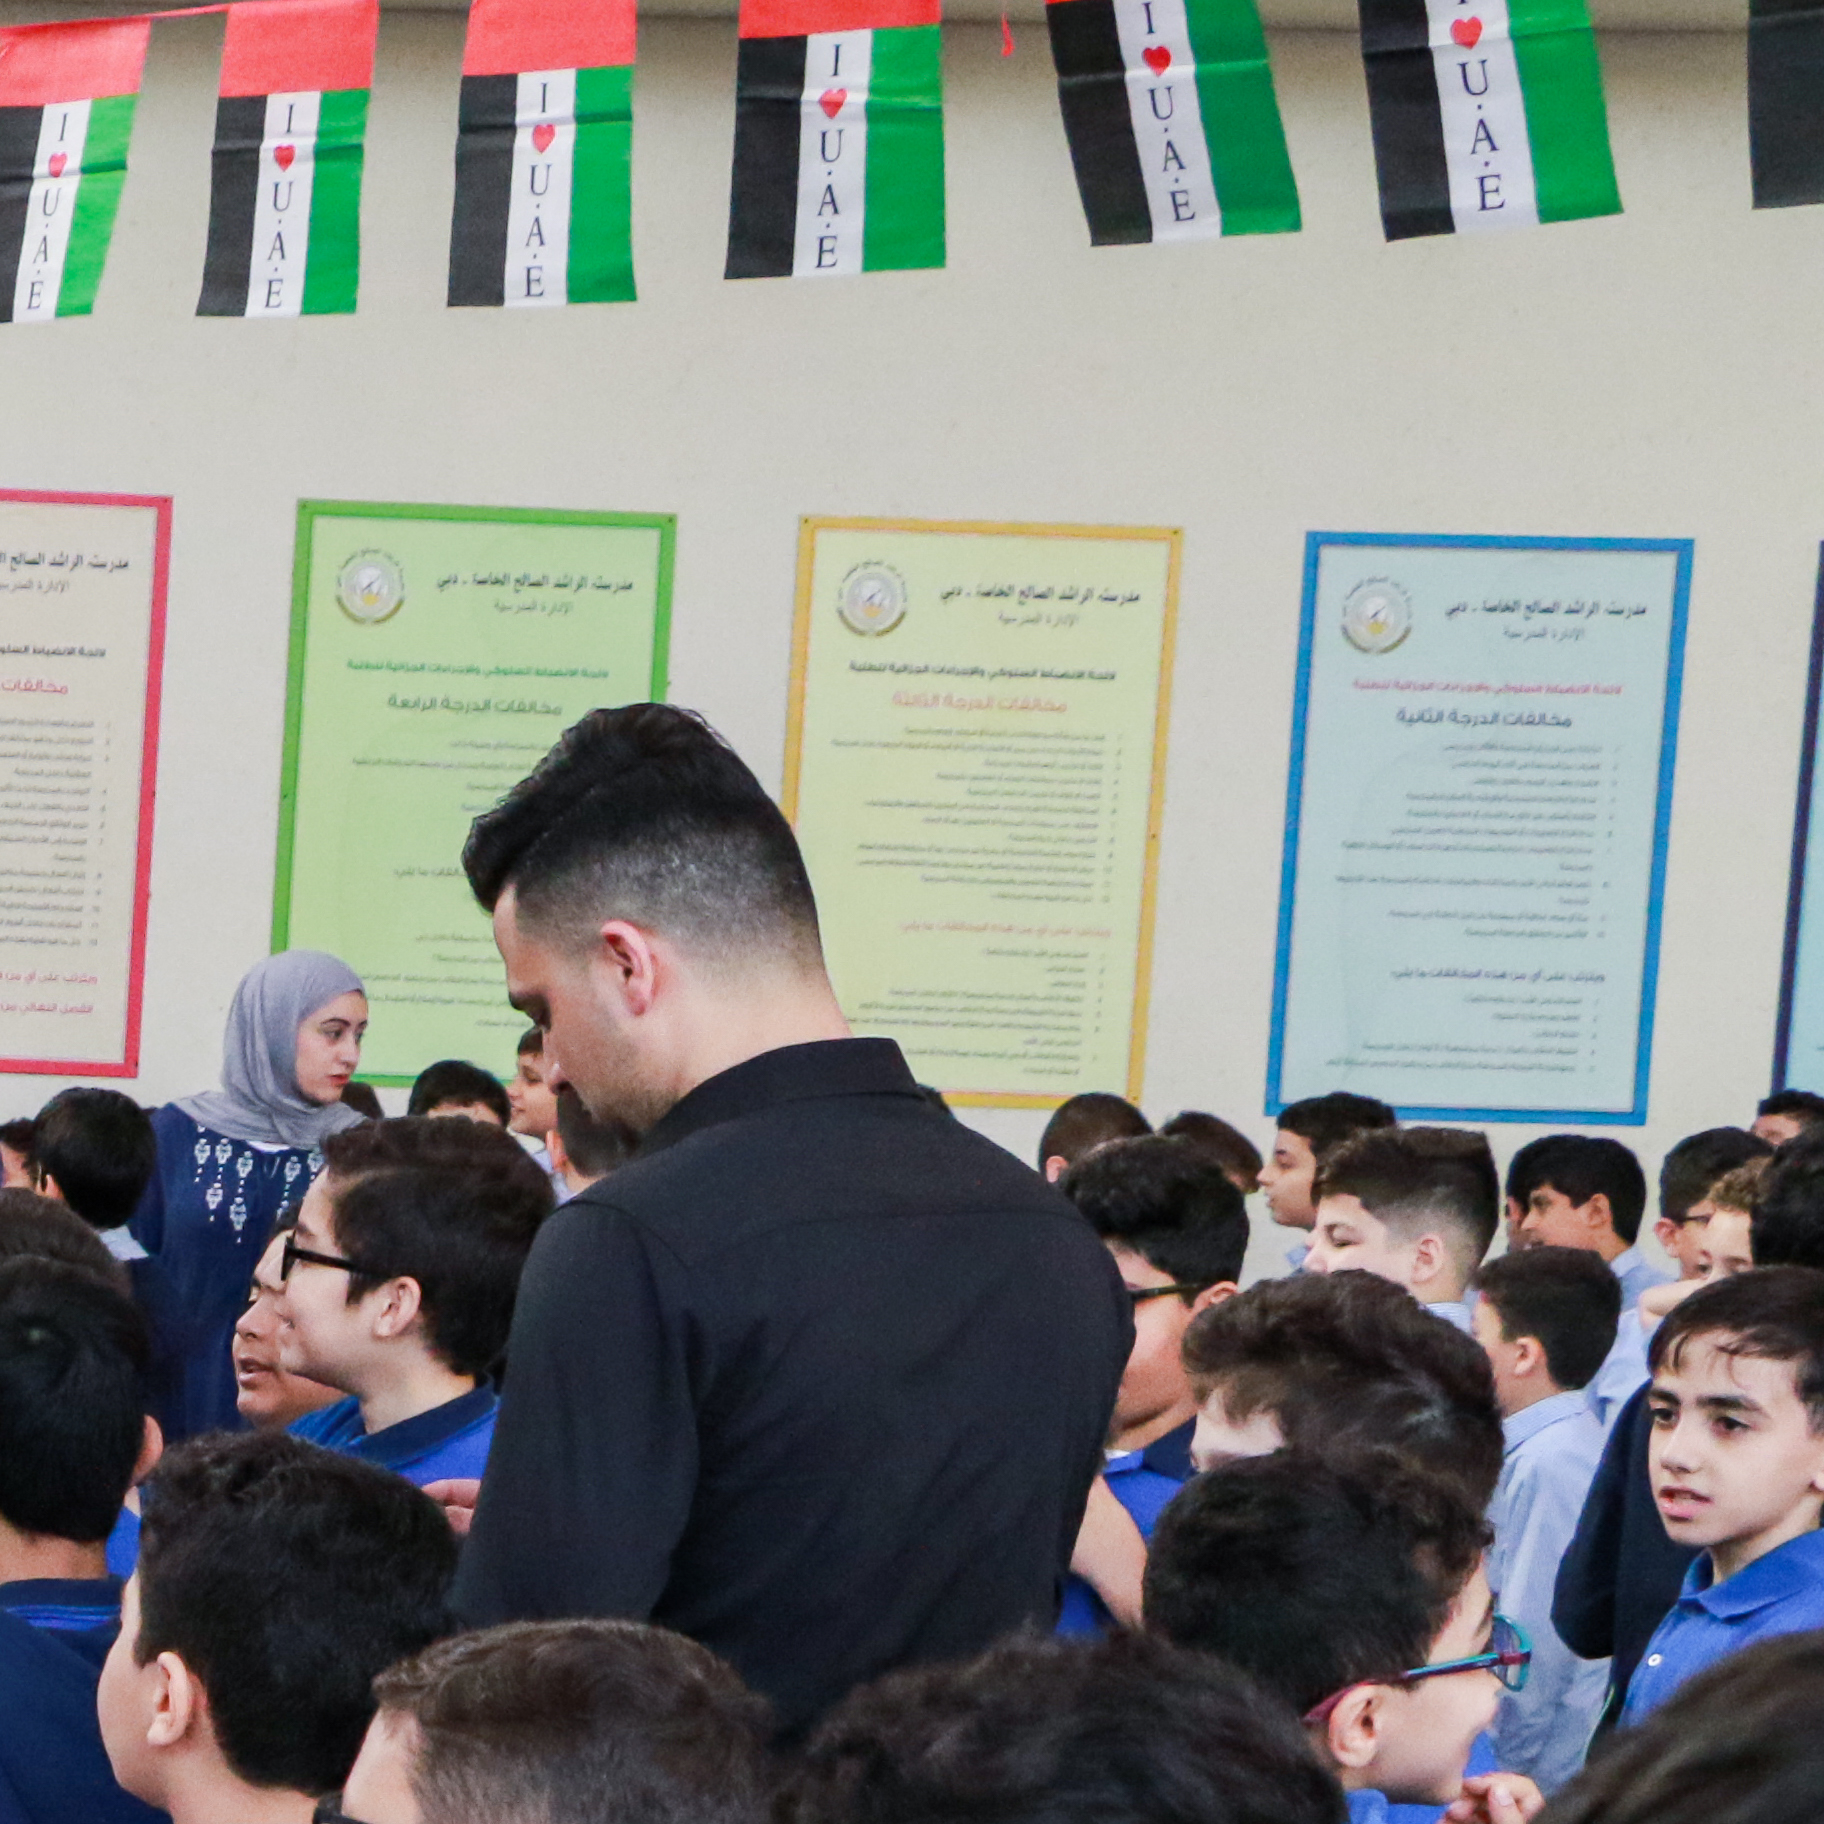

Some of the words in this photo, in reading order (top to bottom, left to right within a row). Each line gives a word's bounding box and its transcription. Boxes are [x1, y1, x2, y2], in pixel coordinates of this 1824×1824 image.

[1140, 1, 1157, 36] I
[830, 44, 844, 78] I
[539, 82, 549, 113] I
[58, 112, 69, 141] I
[284, 103, 297, 134] I
[10, 552, 45, 572] الصالح
[49, 553, 83, 573] الراشد
[87, 554, 129, 573] مدرسة
[437, 573, 458, 592] دبي
[472, 572, 511, 586] الخاصة
[513, 573, 549, 593] الصالح
[552, 574, 588, 594] الراشد
[592, 575, 633, 594] مدرسة
[940, 586, 963, 605] دبي
[976, 583, 1015, 598] الخاصة
[1017, 585, 1055, 606] الصالح
[1058, 586, 1095, 605] الراشد
[1097, 587, 1140, 606] مدرسة
[1445, 601, 1466, 622] دبي
[1482, 599, 1520, 613] الخاصة
[1522, 600, 1560, 621] الصالح
[1564, 600, 1600, 619] الراشد
[1604, 601, 1646, 619] مدرسة
[2, 677, 69, 695] مخالفات
[388, 693, 437, 711] الرابعة
[440, 695, 491, 714] الدرجة
[494, 699, 562, 716] مخالفات
[892, 691, 940, 708] الثالثة
[942, 693, 994, 711] الدرجة
[997, 695, 1067, 713] مخالفات
[1396, 706, 1444, 727] الثانية
[1448, 708, 1499, 728] الدرجة
[1503, 711, 1571, 728] مخالفات
